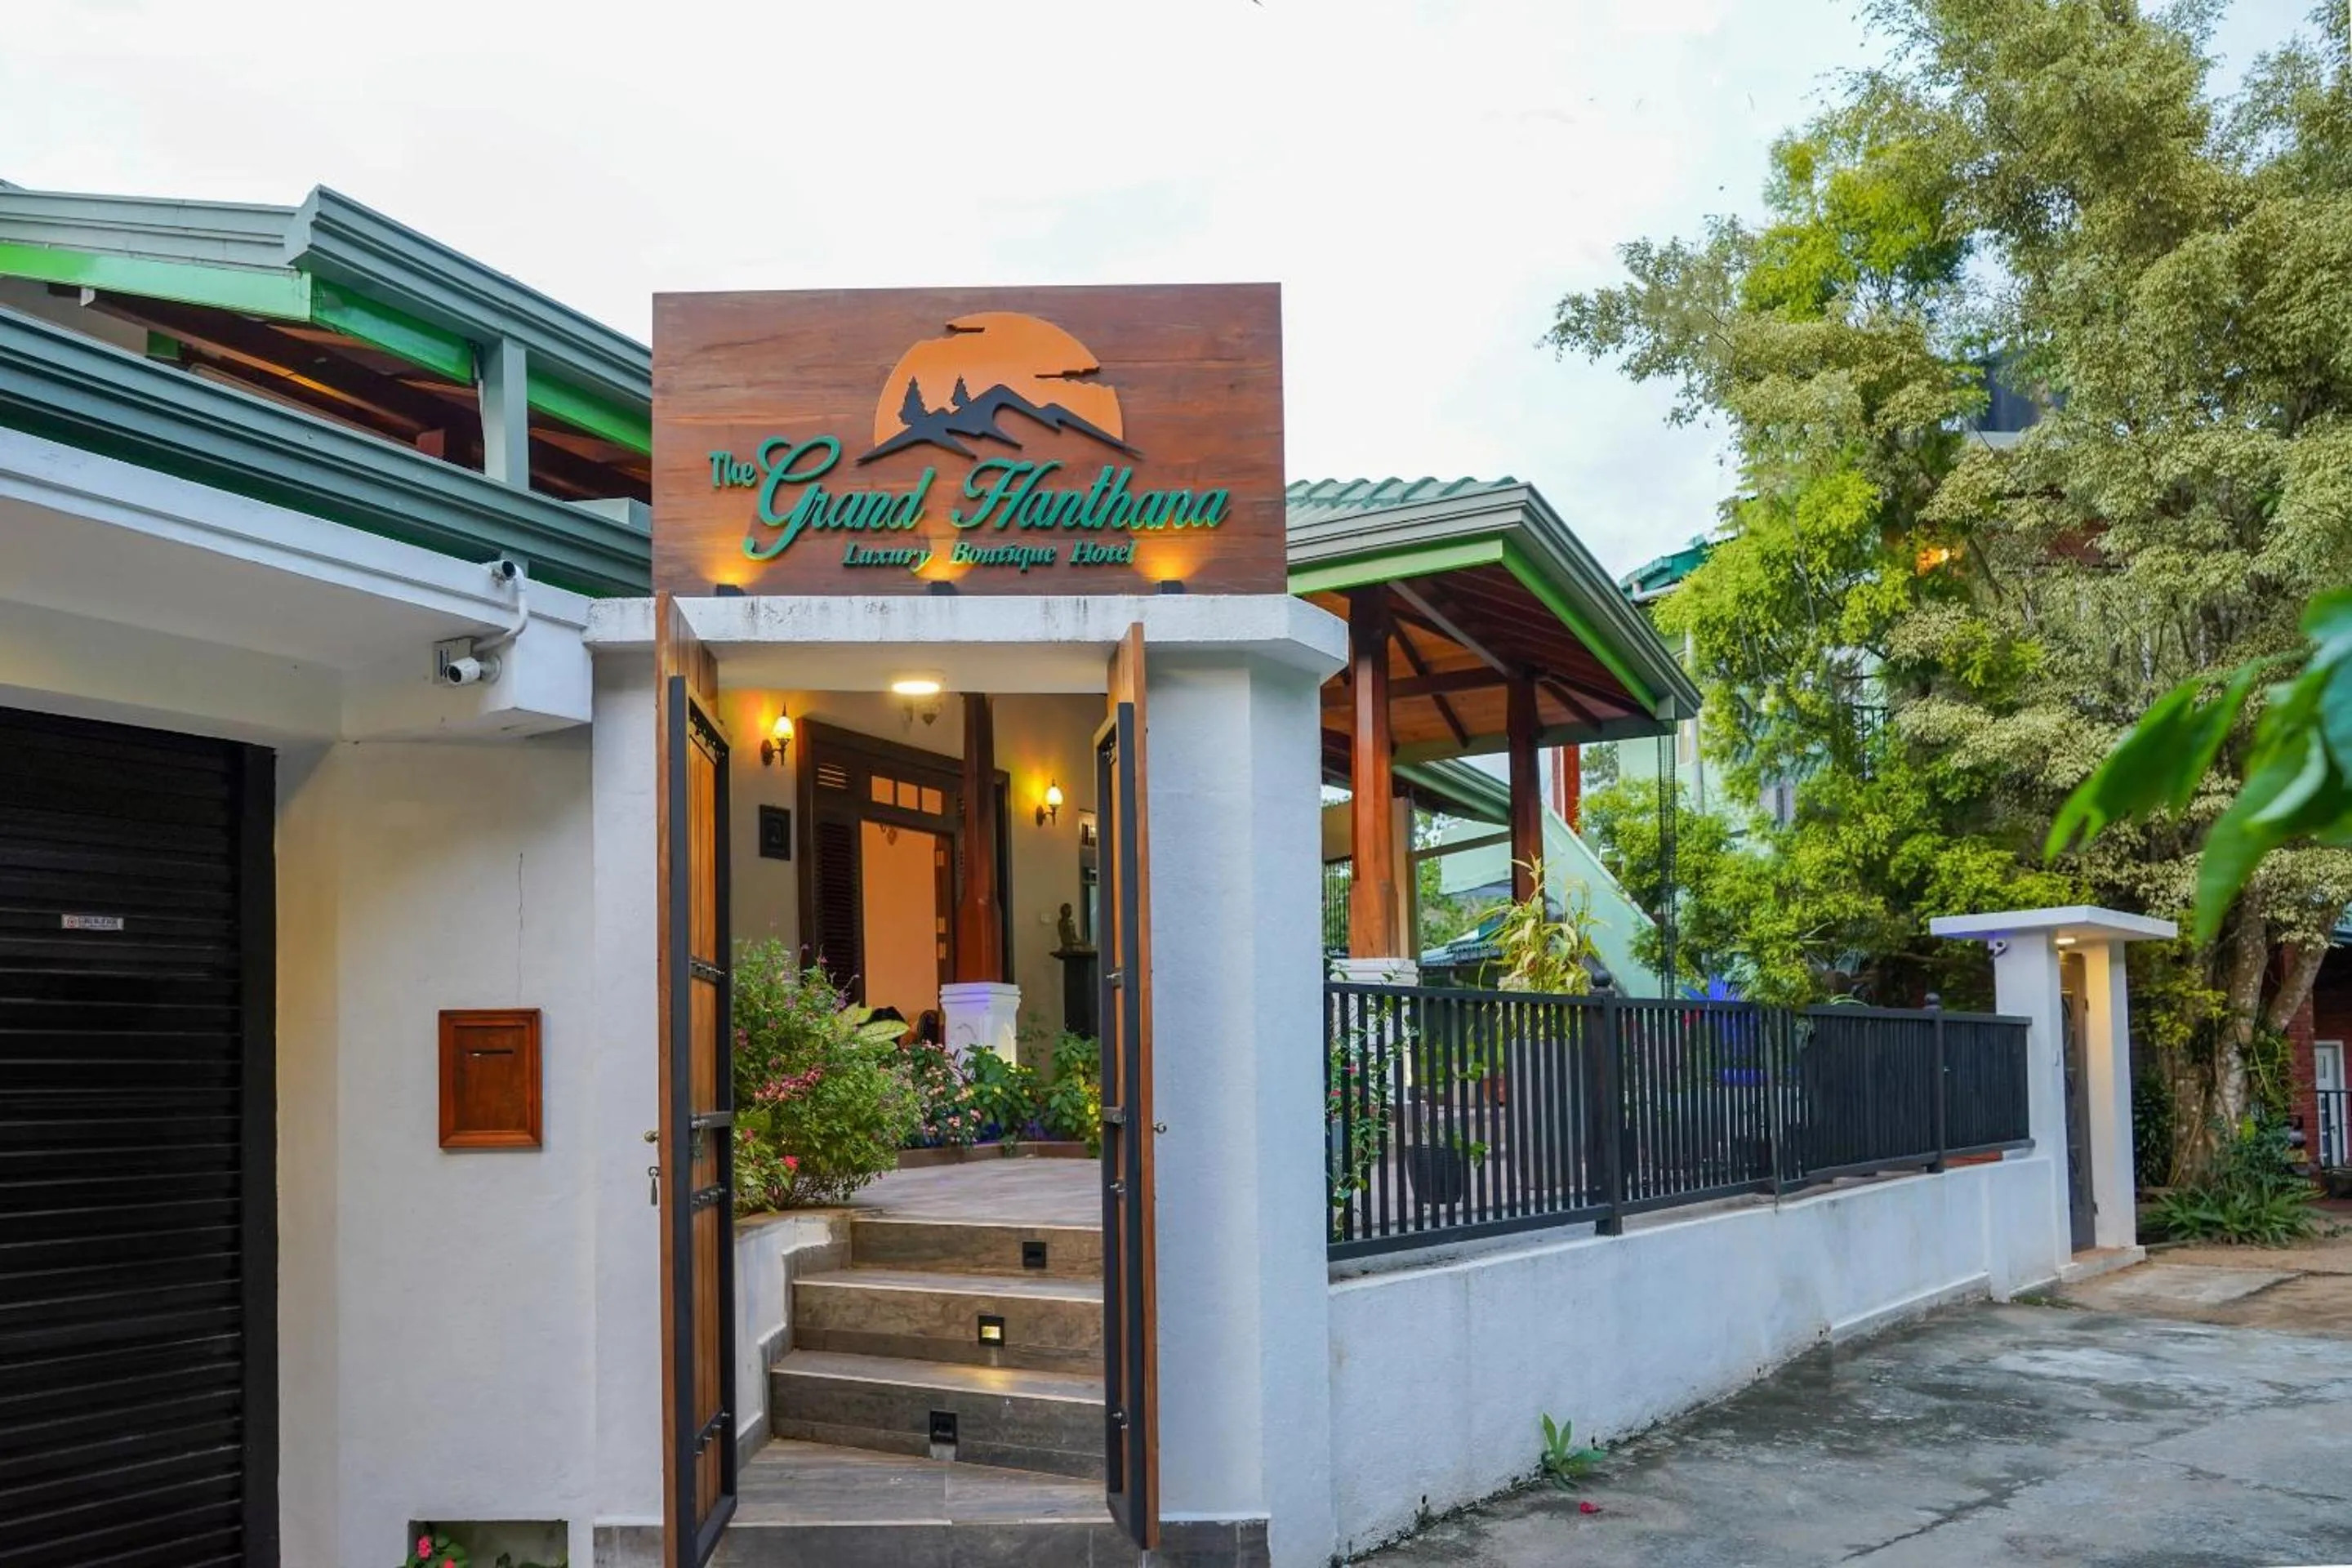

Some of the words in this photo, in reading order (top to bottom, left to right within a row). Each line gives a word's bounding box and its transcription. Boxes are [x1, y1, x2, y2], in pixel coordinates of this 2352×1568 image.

[709, 450, 756, 488] The
[742, 434, 937, 560] Grand
[951, 457, 1232, 530] Hanthana
[841, 541, 933, 574] Luxury
[949, 541, 1057, 573] Boutique
[1069, 539, 1137, 565] Hotel
